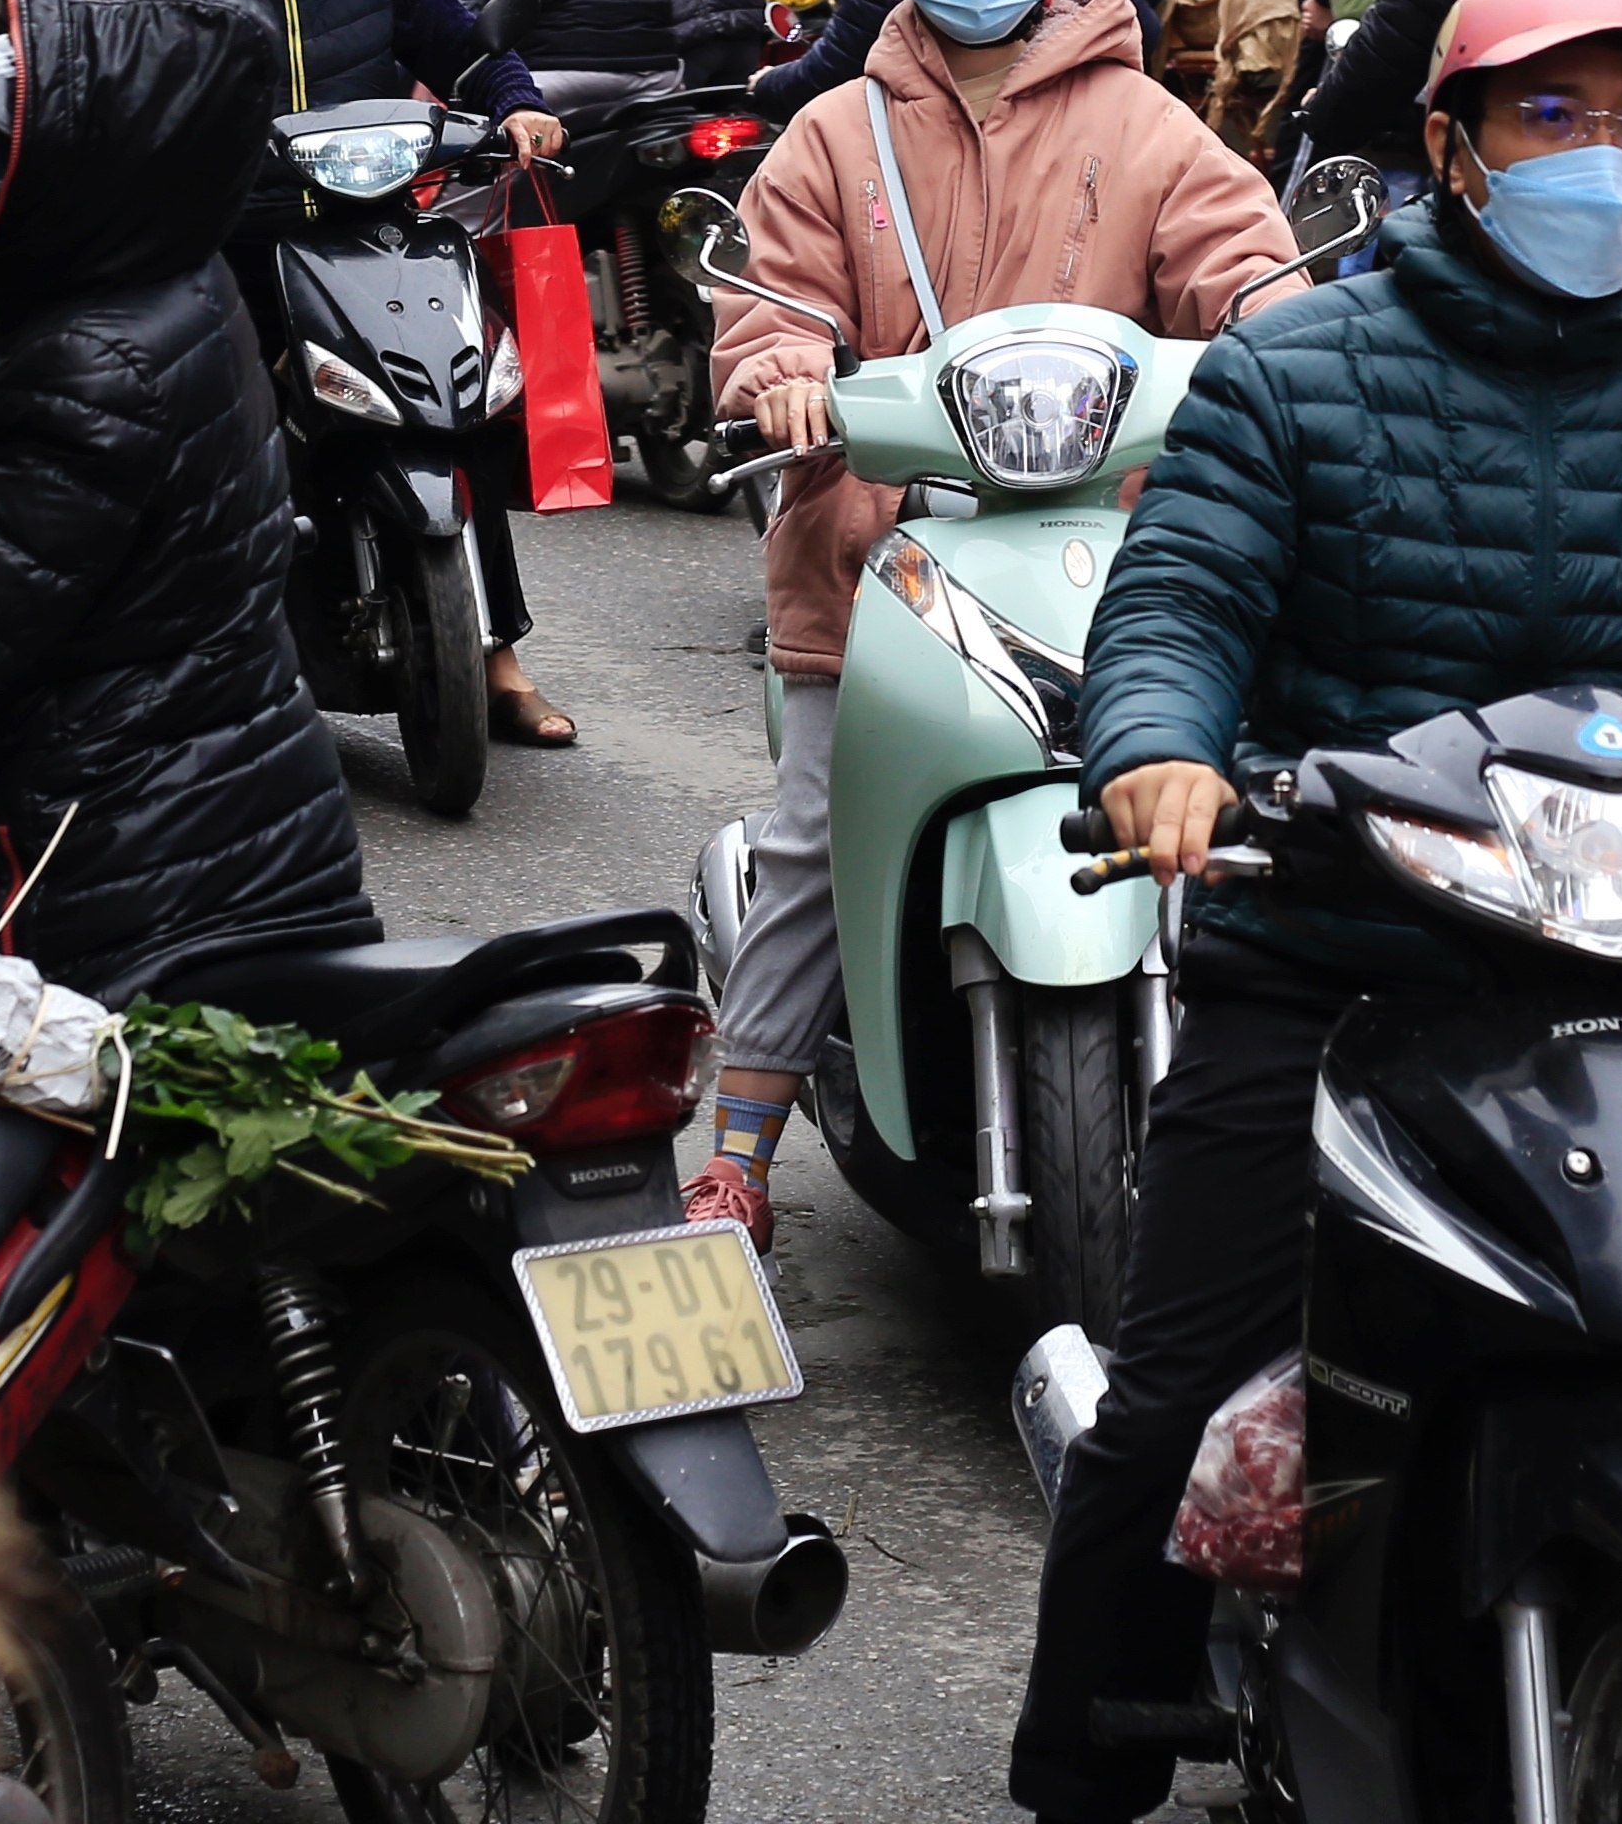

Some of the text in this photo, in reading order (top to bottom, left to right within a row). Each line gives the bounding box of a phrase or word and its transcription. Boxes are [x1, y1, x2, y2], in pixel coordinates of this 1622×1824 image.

[1039, 520, 1107, 530] HONDA
[570, 1162, 641, 1185] HONDA
[555, 1241, 732, 1332] 29-D1
[570, 1318, 779, 1414] 179.61
